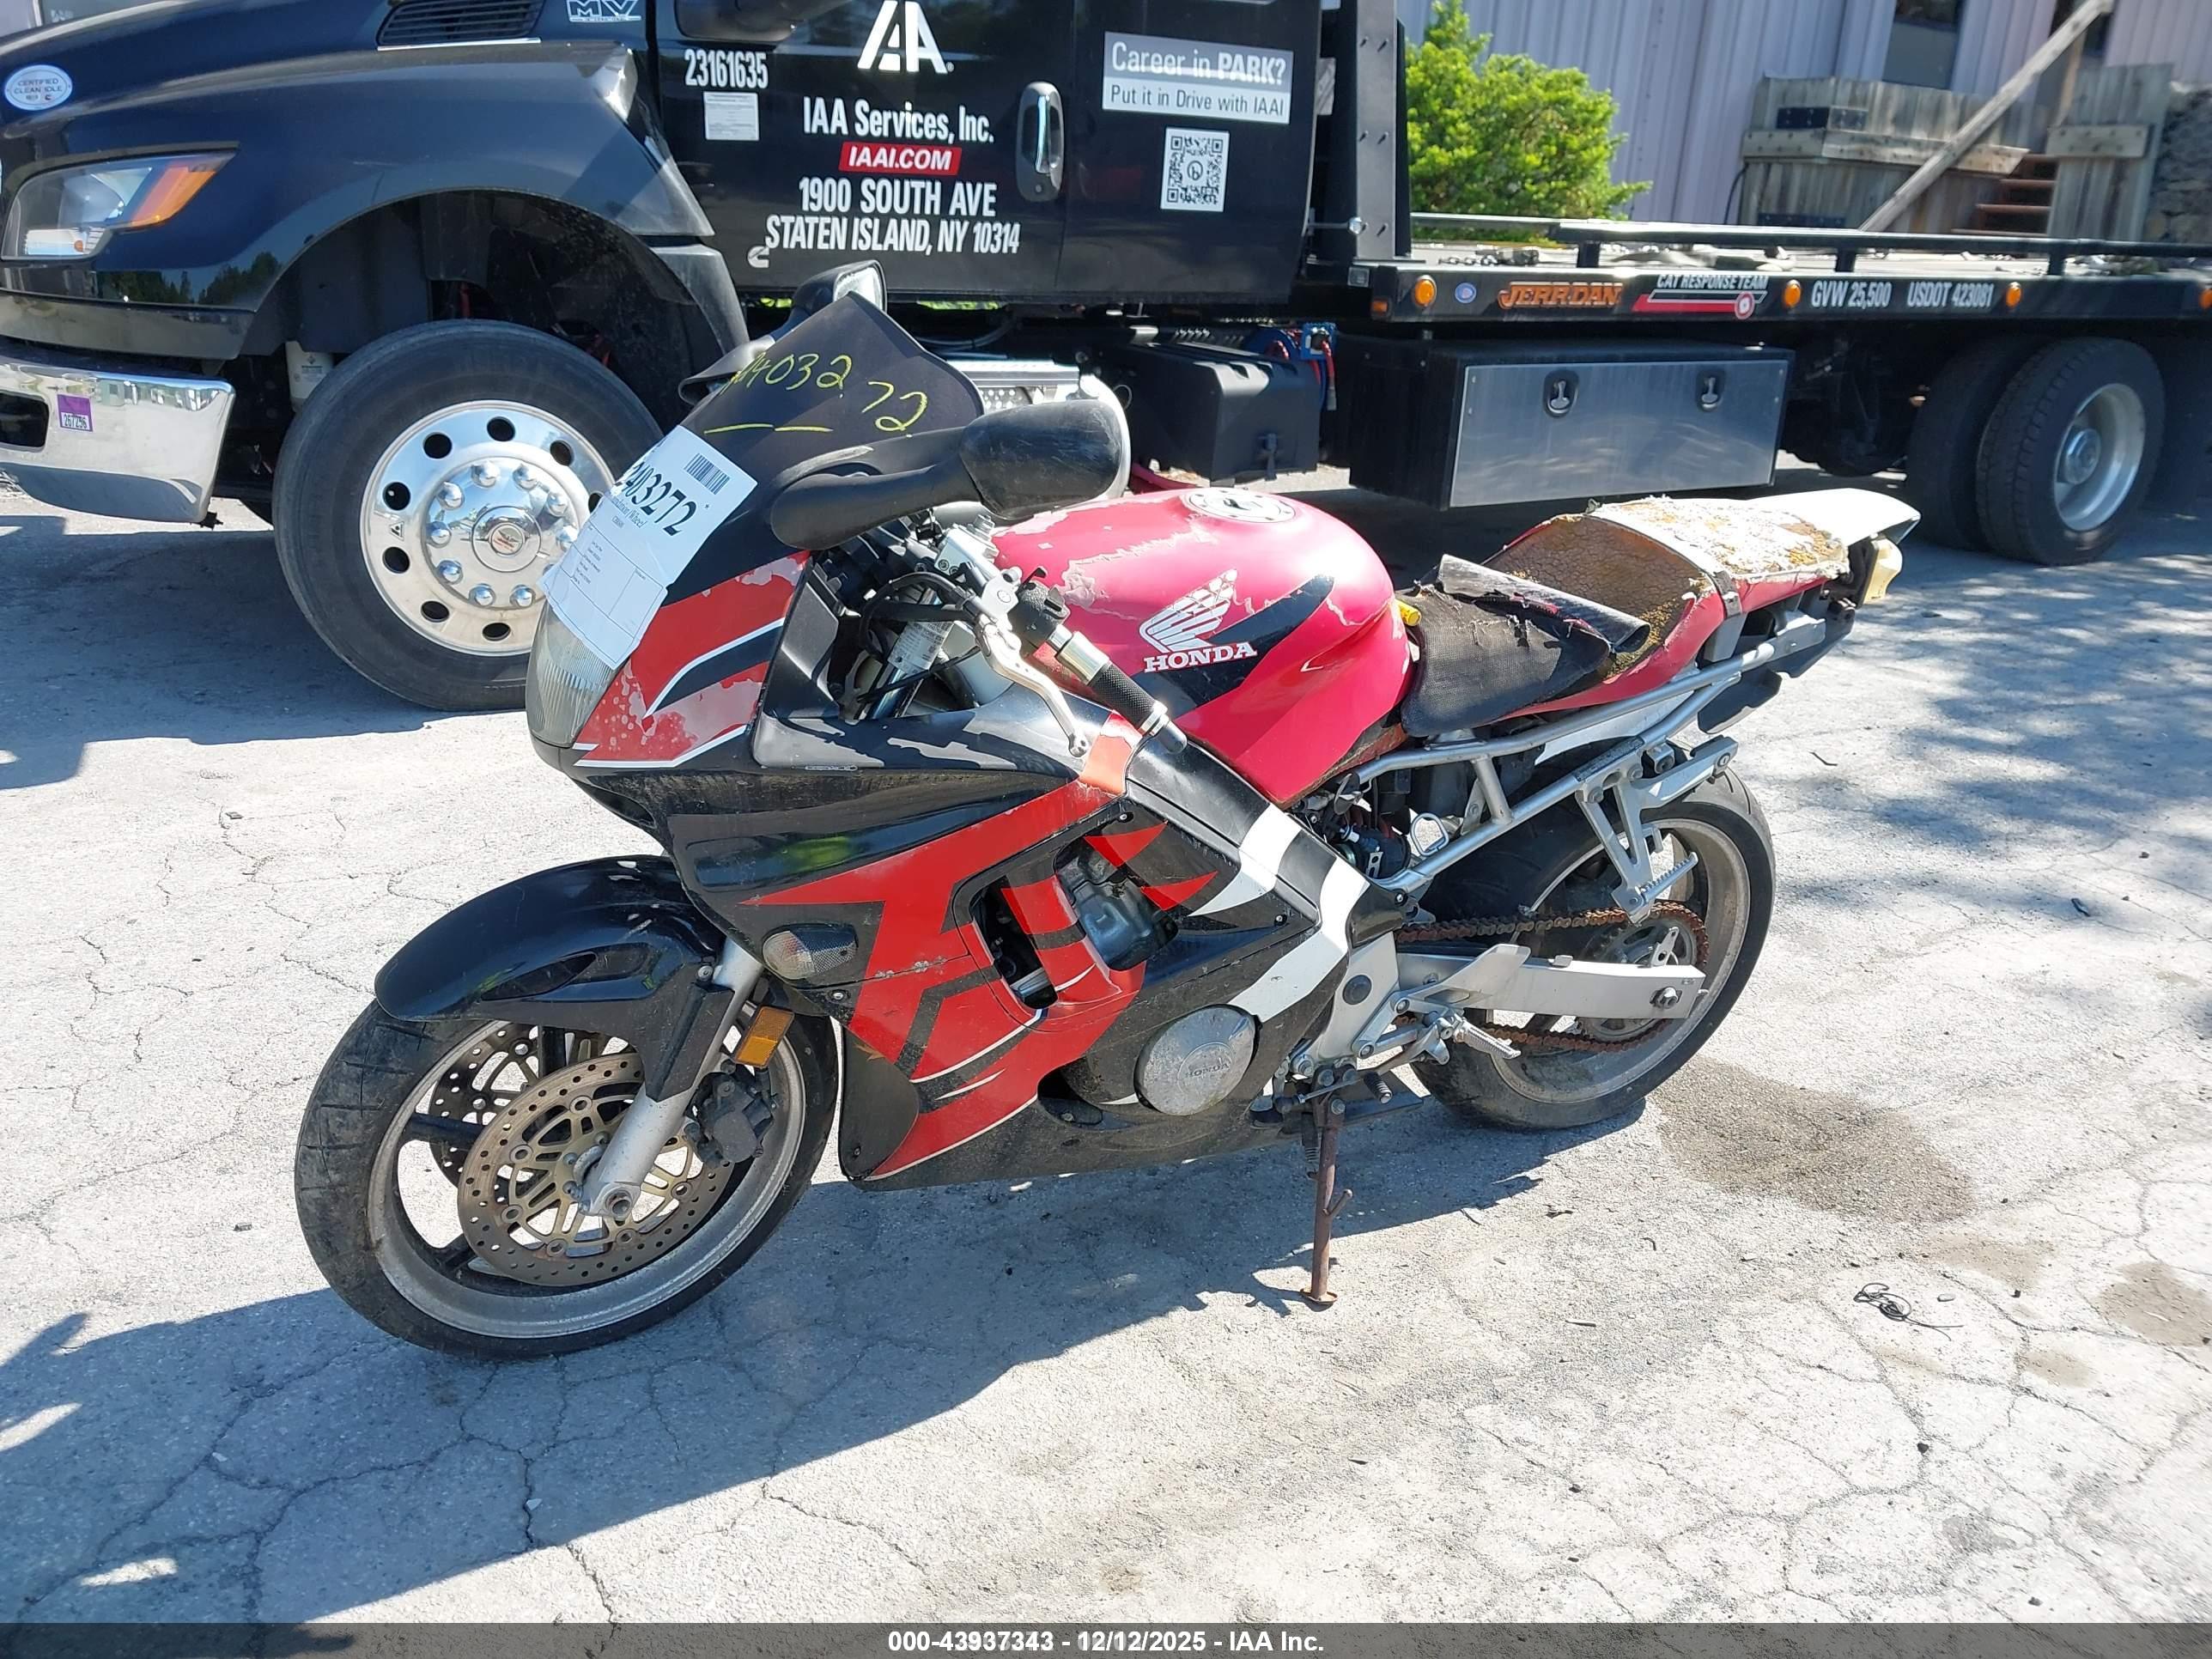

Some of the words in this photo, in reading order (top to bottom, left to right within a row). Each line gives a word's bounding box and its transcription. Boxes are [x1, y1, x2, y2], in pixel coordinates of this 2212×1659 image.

[567, 0, 638, 17] MV
[684, 48, 769, 89] 23161635
[1112, 41, 1186, 75] Career
[1193, 49, 1211, 78] in
[1217, 52, 1286, 85] PARK?
[1110, 84, 1136, 105] Put
[1141, 86, 1152, 106] it
[1157, 88, 1170, 106] in
[1176, 89, 1212, 110] Drive
[1218, 94, 1248, 113] with
[1253, 96, 1284, 117] IAAI
[803, 96, 849, 136] IAA
[854, 99, 955, 144] Services,
[958, 105, 994, 143] Inc.
[848, 146, 952, 171] IAAI.COM
[799, 177, 852, 212] 1900
[860, 178, 941, 215] SOUTH
[949, 182, 997, 216] AVE
[765, 215, 846, 251] STATEN
[851, 216, 933, 255] ISLAND,
[937, 220, 969, 252] NY
[973, 222, 1020, 254] 10314
[1656, 274, 1680, 289] CAT
[1680, 274, 1738, 289] RESPONSE
[1736, 274, 1769, 289] TEAM
[1811, 280, 1848, 307] GVW
[1848, 281, 1893, 310] 25,500
[1906, 282, 1952, 307] USDOT
[1952, 283, 1995, 307] 423081
[1143, 641, 1257, 673] HONDA
